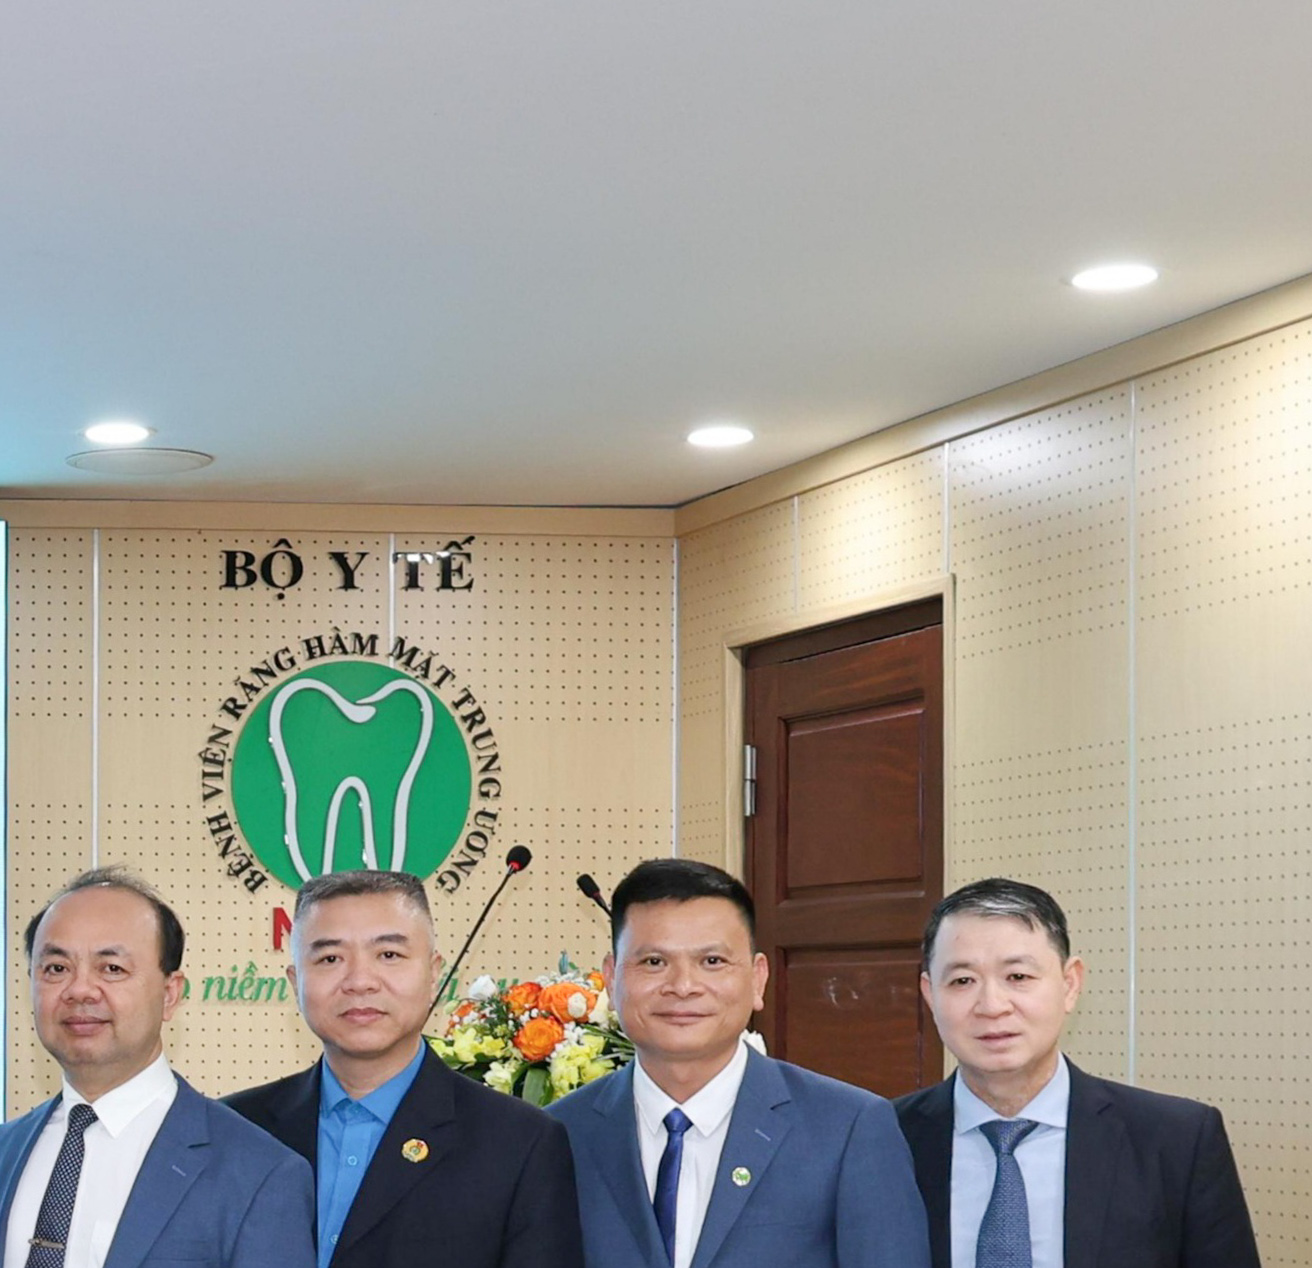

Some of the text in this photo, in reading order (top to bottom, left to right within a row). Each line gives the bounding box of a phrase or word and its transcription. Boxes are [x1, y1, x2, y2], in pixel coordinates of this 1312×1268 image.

[220, 535, 475, 600] BỘ Y TẾ
[198, 626, 502, 894] BỆNH VIỆN RĂNG HÀM MẶT TRUNG ƯƠNG
[202, 960, 288, 1001] niềm
